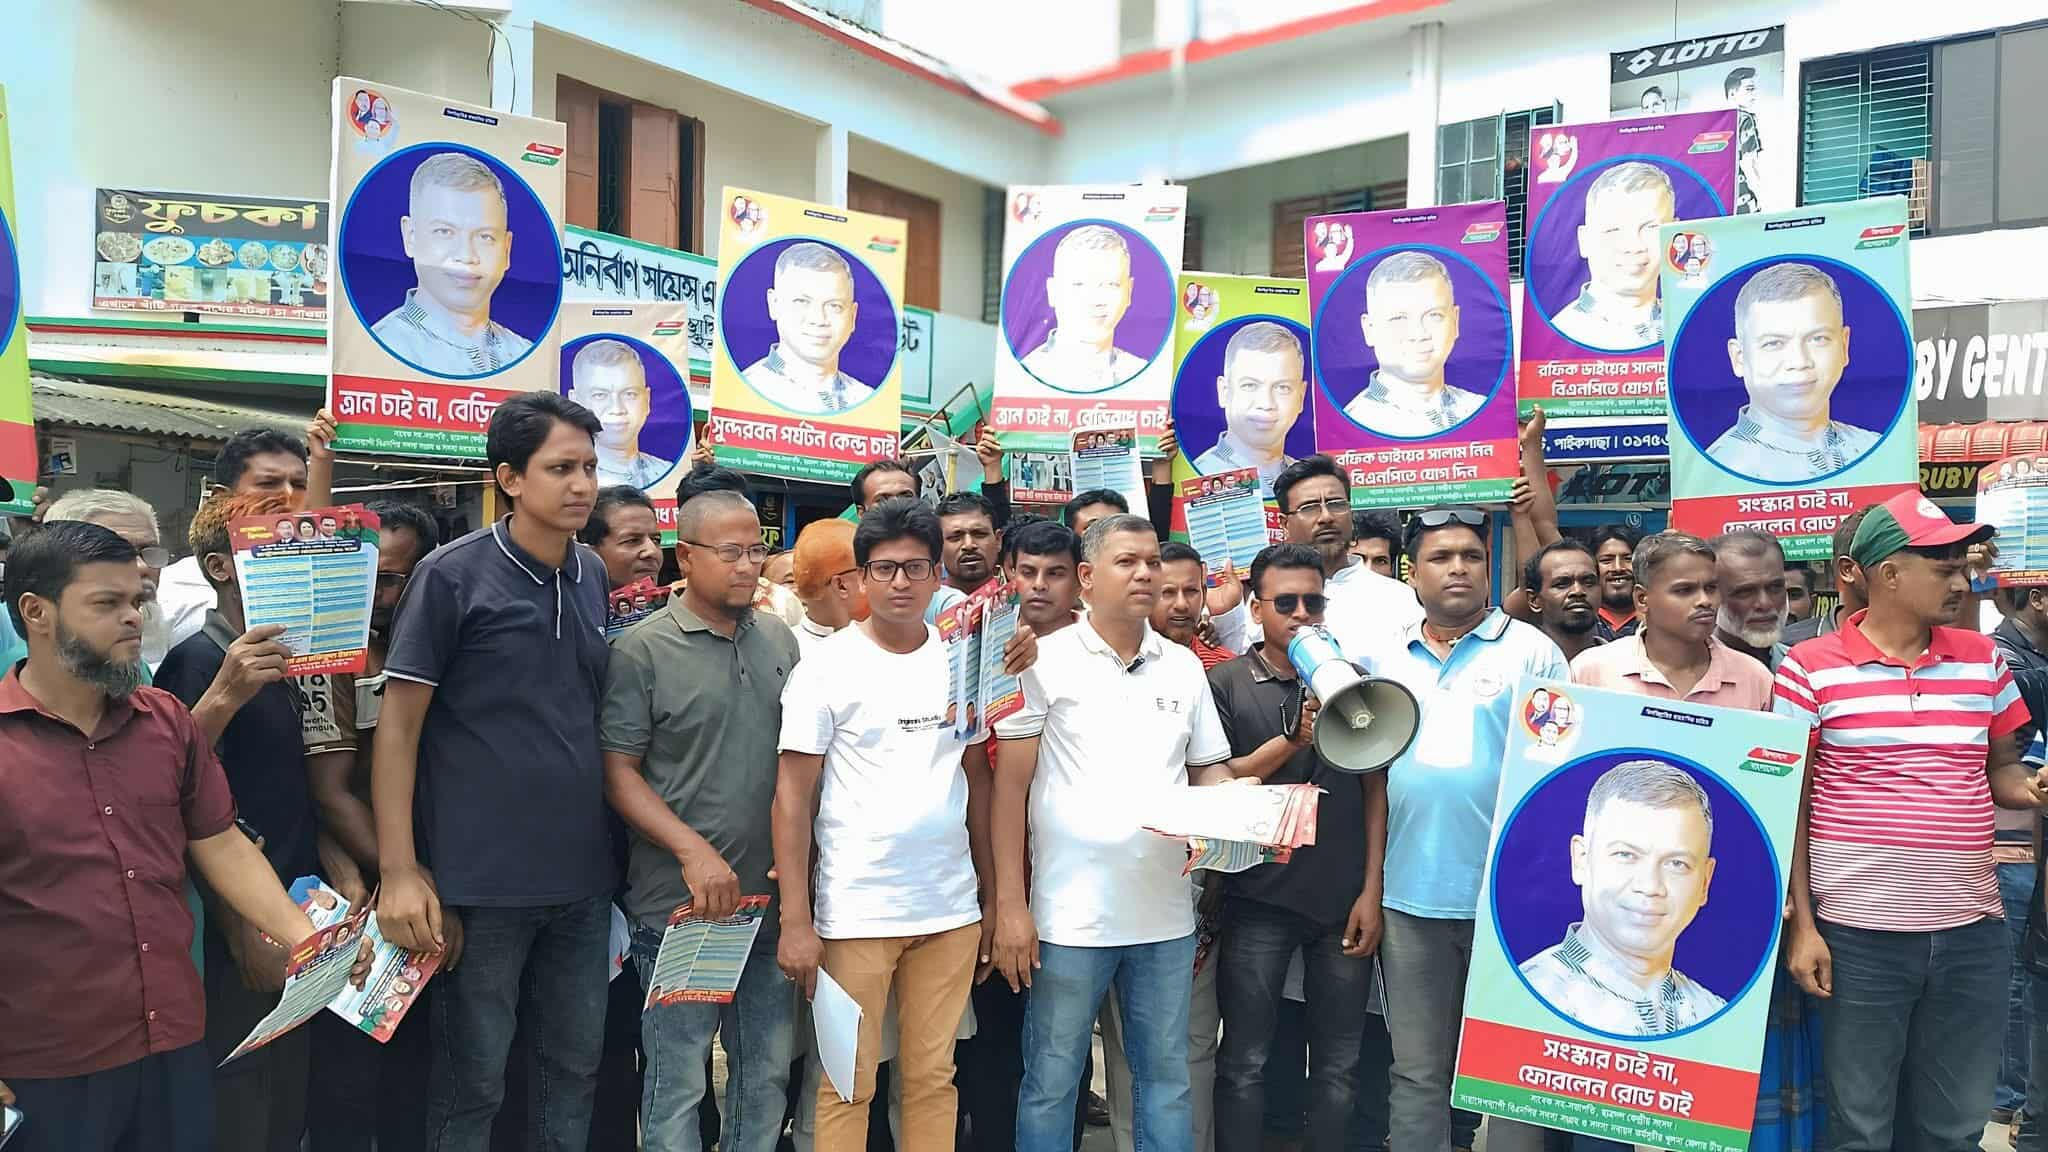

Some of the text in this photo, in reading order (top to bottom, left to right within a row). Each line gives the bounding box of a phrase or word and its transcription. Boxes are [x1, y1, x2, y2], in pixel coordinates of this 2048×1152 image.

[1658, 30, 1770, 66] LOTTO
[138, 198, 318, 234] ফুচকা
[563, 241, 640, 297] অনির্বাণ
[1538, 361, 1578, 376] রফিক
[1582, 360, 1628, 376] ভাইয়ের
[1915, 338, 1958, 400] BY
[1552, 379, 1618, 397] বিএনপিতে
[1622, 382, 1653, 395] যোগ
[381, 389, 414, 420] চাই
[416, 397, 442, 424] না,
[1027, 404, 1051, 428] চাই
[1140, 406, 1167, 431] চাই
[712, 415, 897, 460] সুন্দরবন পর্যটন কেন্দ্র চাই
[1428, 445, 1467, 460] সালাম
[1470, 441, 1494, 457] নিন
[1350, 463, 1478, 486] বিএনপিতে যোগ দিন
[1738, 490, 1853, 514] সংস্কার চাই না,
[1800, 515, 1837, 532] রোড
[1543, 1039, 1679, 1086] সংস্কার চাই না,
[1518, 1063, 1694, 1118] ফোরলেন রোড চাই
